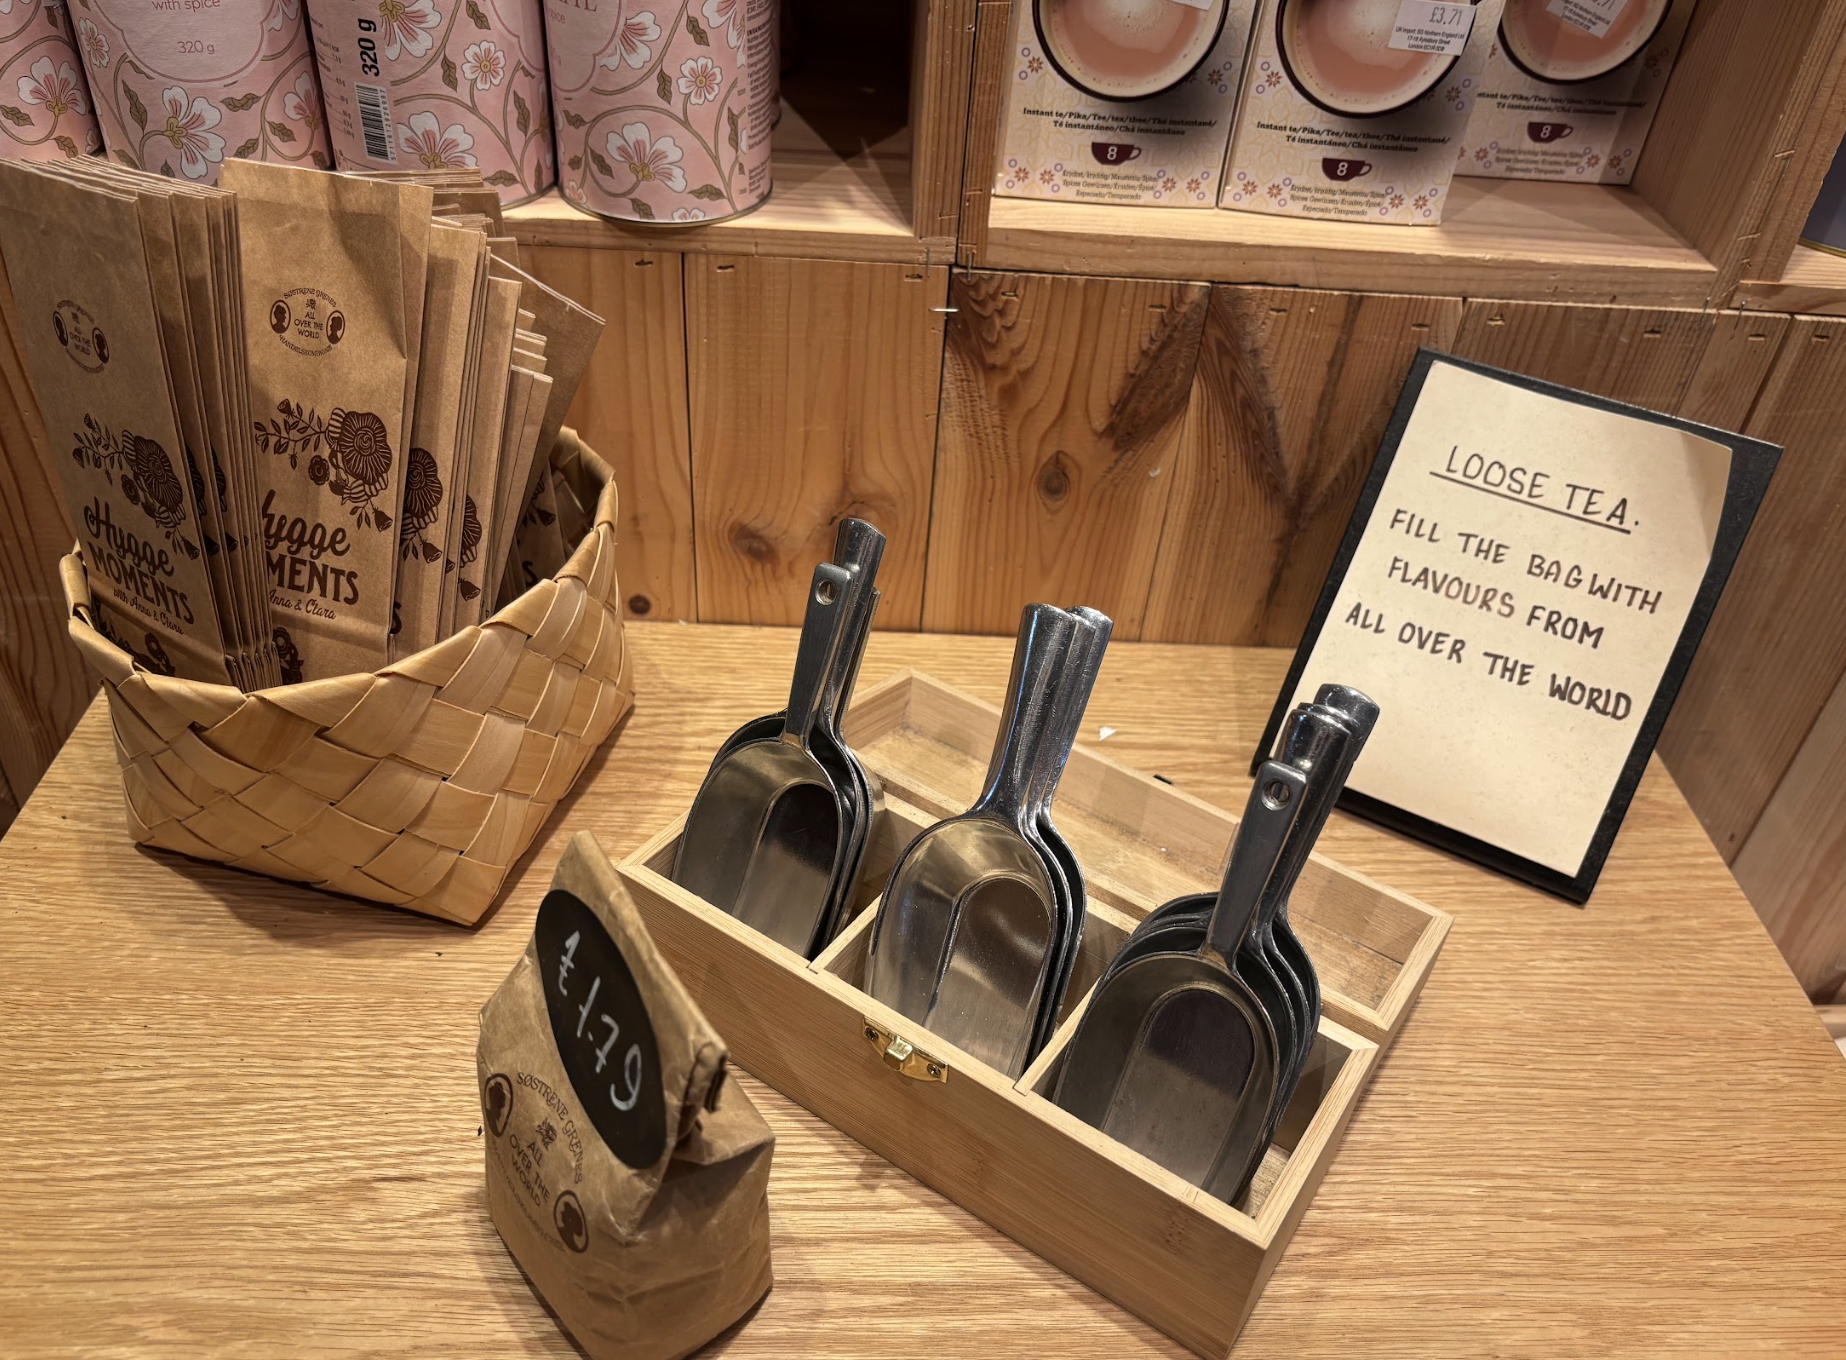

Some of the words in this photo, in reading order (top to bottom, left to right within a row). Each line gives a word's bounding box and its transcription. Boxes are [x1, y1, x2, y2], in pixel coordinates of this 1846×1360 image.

[358, 18, 376, 32] g
[1429, 6, 1462, 26] £3.71
[177, 40, 204, 54] 320
[206, 44, 214, 54] g
[358, 38, 380, 77] 320
[1023, 108, 1054, 117] Instant
[1256, 122, 1287, 132] Instant
[1540, 125, 1552, 139] 8
[1106, 146, 1118, 160] 8
[1336, 162, 1348, 176] 8
[294, 318, 312, 328] OVER
[314, 321, 324, 330] THE
[304, 312, 316, 320] ALL
[297, 328, 320, 339] WORLD
[1445, 445, 1551, 499] LOOSE
[1565, 483, 1640, 527] TEA.
[84, 496, 175, 578] Hygge
[1389, 508, 1441, 543] FILL
[1458, 532, 1510, 565] THE
[1527, 553, 1583, 589] BAG
[1588, 573, 1663, 615] WITH
[87, 541, 194, 624] MOMENTS
[113, 588, 129, 604] with
[130, 596, 152, 618] Anna
[160, 612, 184, 635] Clara
[294, 600, 302, 610] &
[305, 598, 337, 620] Clara
[1388, 556, 1516, 619] FLAVOURS
[1526, 605, 1605, 649] FROM
[1345, 602, 1386, 635] ALL
[1397, 621, 1467, 664] OVER
[1482, 651, 1535, 687] THE
[1548, 673, 1632, 722] WORLD
[516, 1071, 570, 1122] SØSTRENE
[562, 1119, 584, 1185] GRENES
[526, 1140, 546, 1168] ALL
[509, 1133, 532, 1172] OVER
[534, 1172, 550, 1204] THE
[511, 1153, 541, 1207] WORLD
